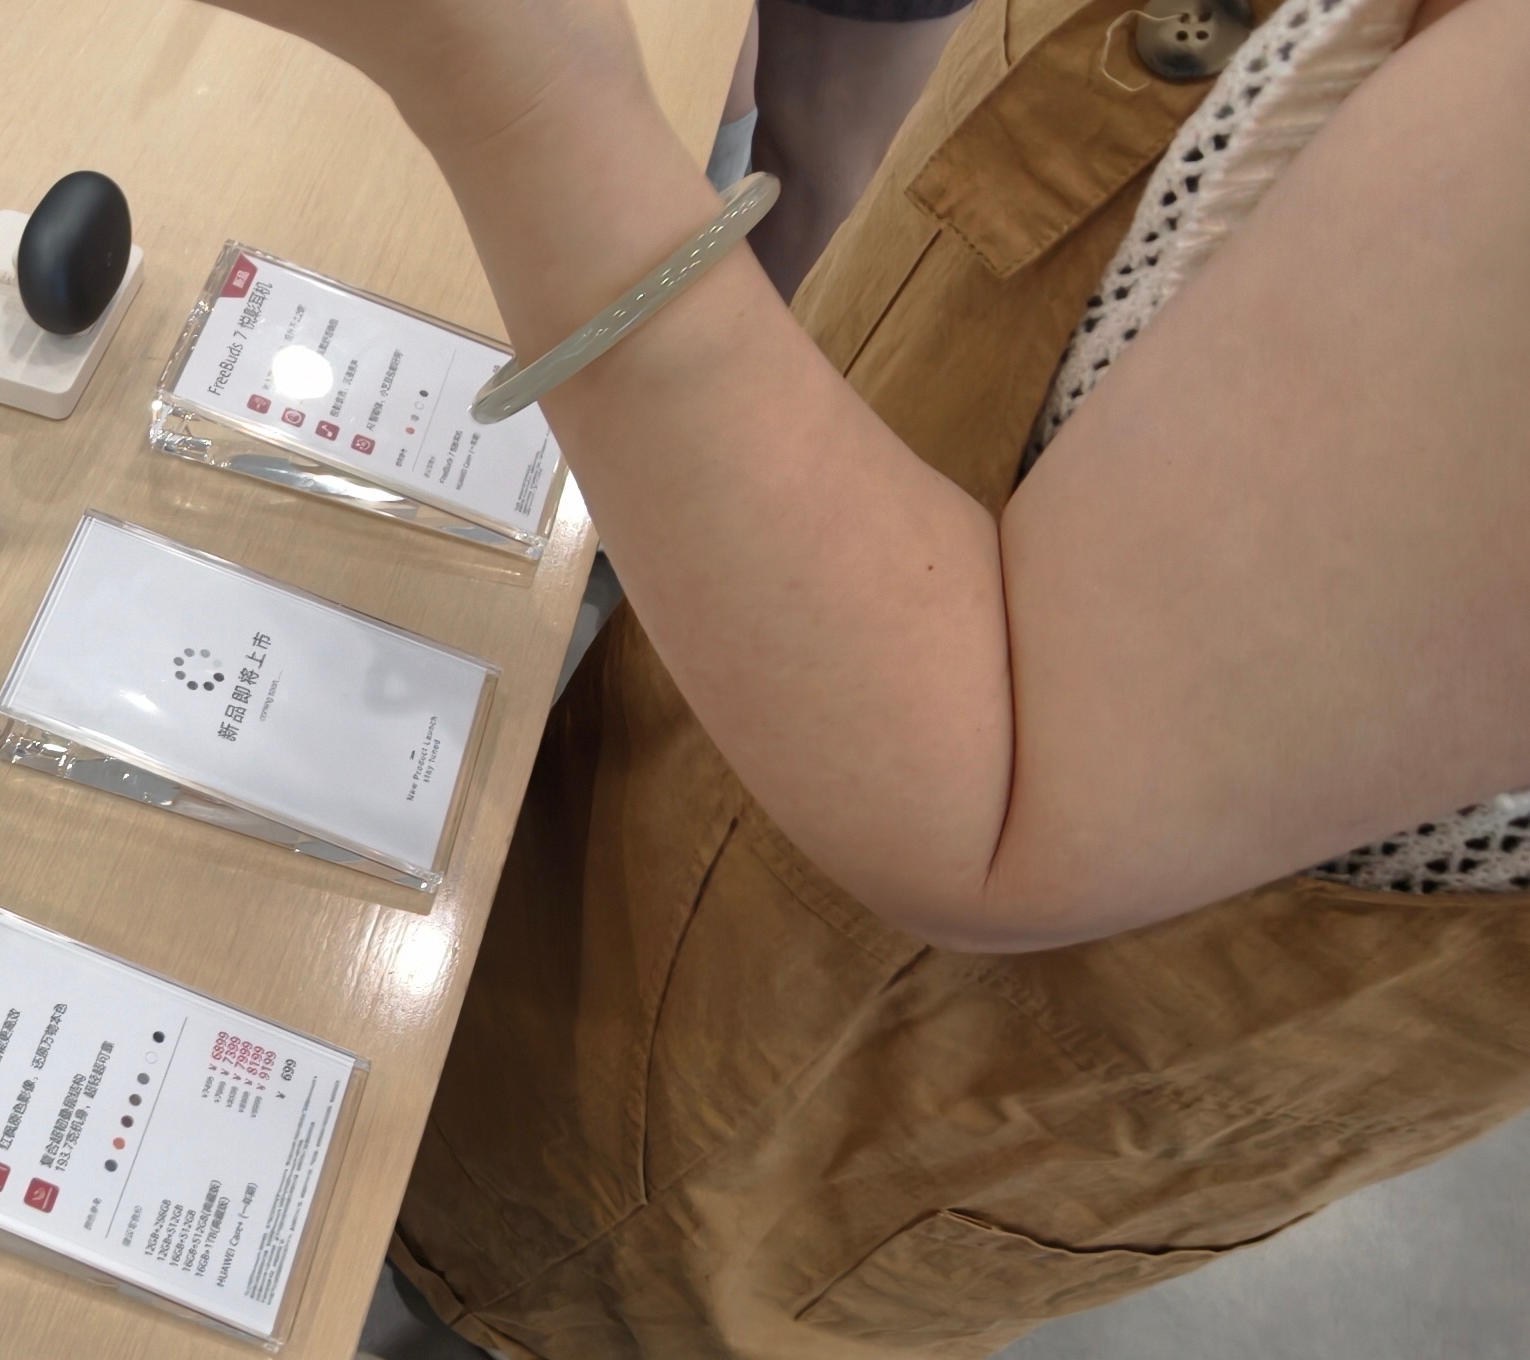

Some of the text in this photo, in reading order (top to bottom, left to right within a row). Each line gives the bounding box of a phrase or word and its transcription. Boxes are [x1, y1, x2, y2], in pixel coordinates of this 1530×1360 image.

[207, 281, 272, 395] FreeBuds 7 悦彰耳机
[217, 632, 270, 741] 新品即将上市
[259, 696, 274, 721] coming
[405, 715, 437, 801] New Product Launch
[422, 738, 441, 783] stay tuned
[211, 1030, 229, 1060] 6899
[233, 1040, 253, 1069] 7999
[246, 1045, 265, 1075] 8199
[258, 1050, 276, 1080] 9199
[156, 1204, 183, 1260] 12GB+512GB
[221, 1035, 241, 1064] 7399
[216, 1247, 235, 1287] HUAWEI
[280, 1058, 296, 1081] 699
